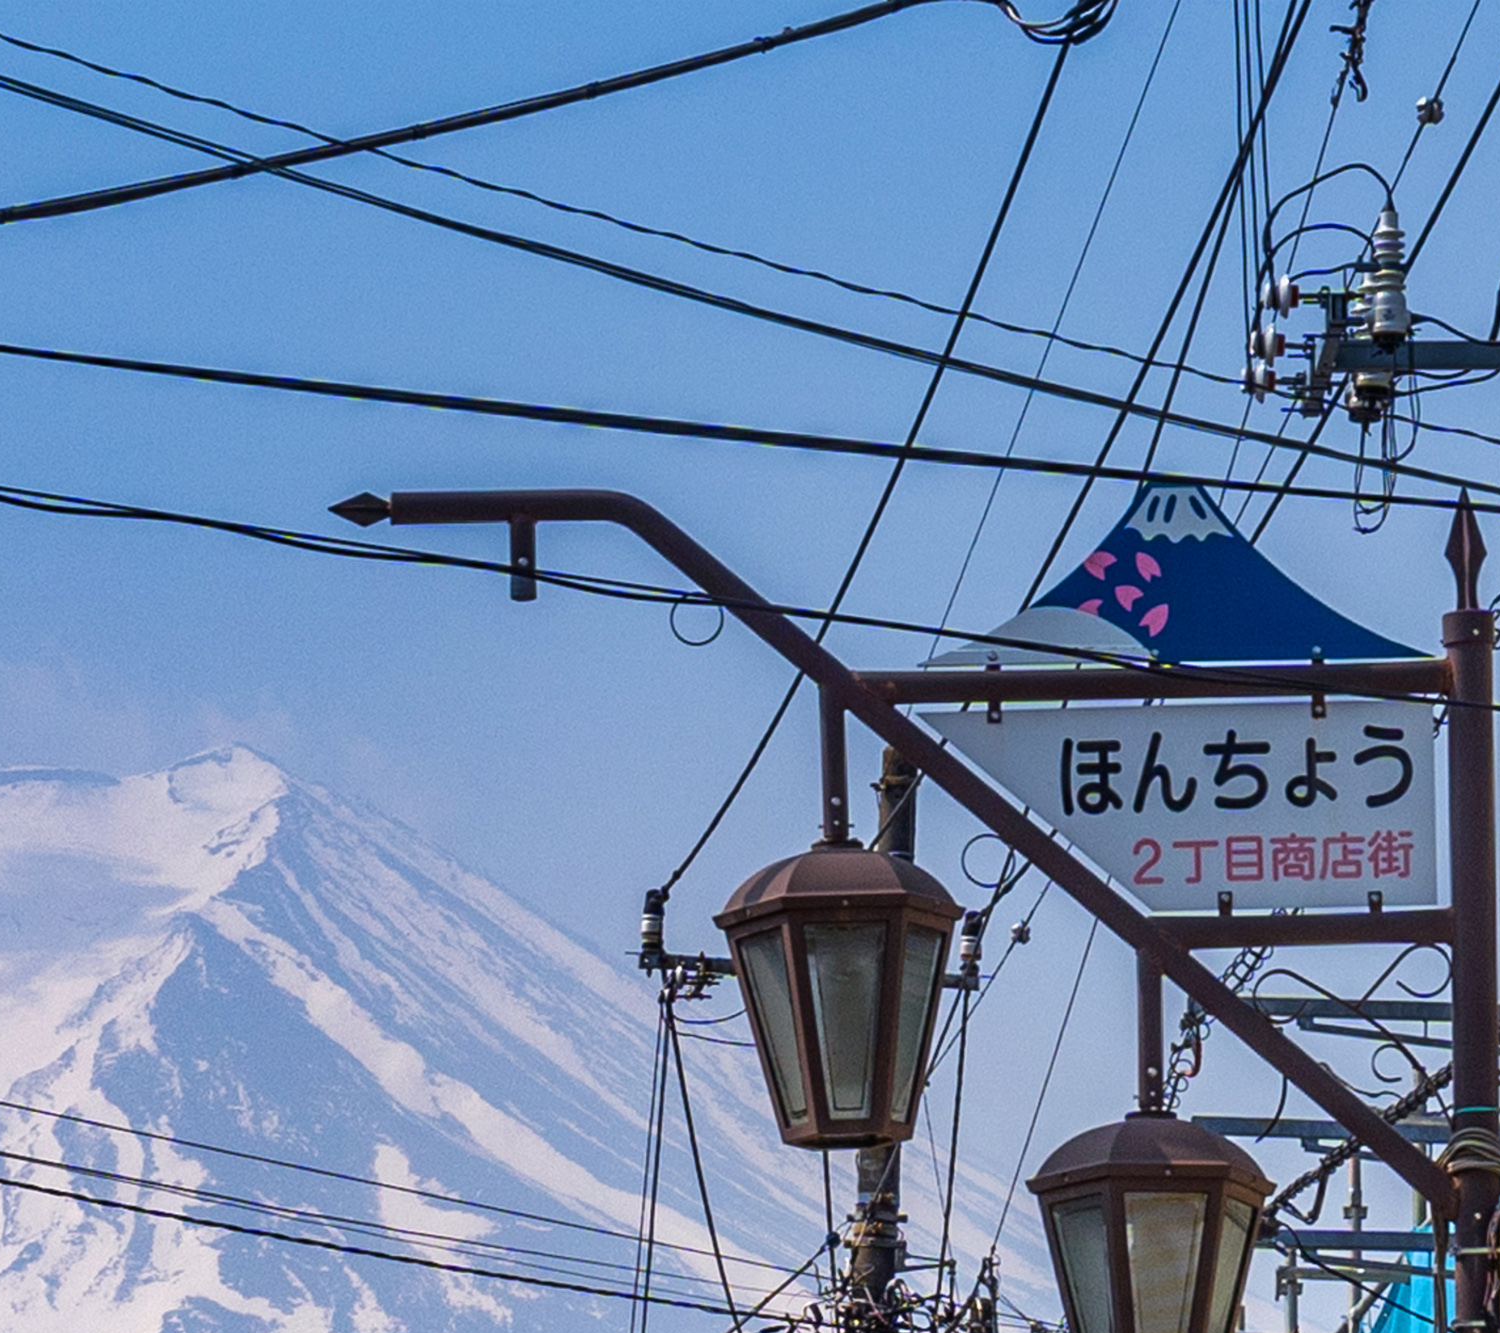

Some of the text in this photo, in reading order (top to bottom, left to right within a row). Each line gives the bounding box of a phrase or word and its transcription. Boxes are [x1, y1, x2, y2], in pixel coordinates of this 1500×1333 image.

[1060, 724, 1414, 816] ほんちょう
[1132, 829, 1415, 886] 2丁目商店街
